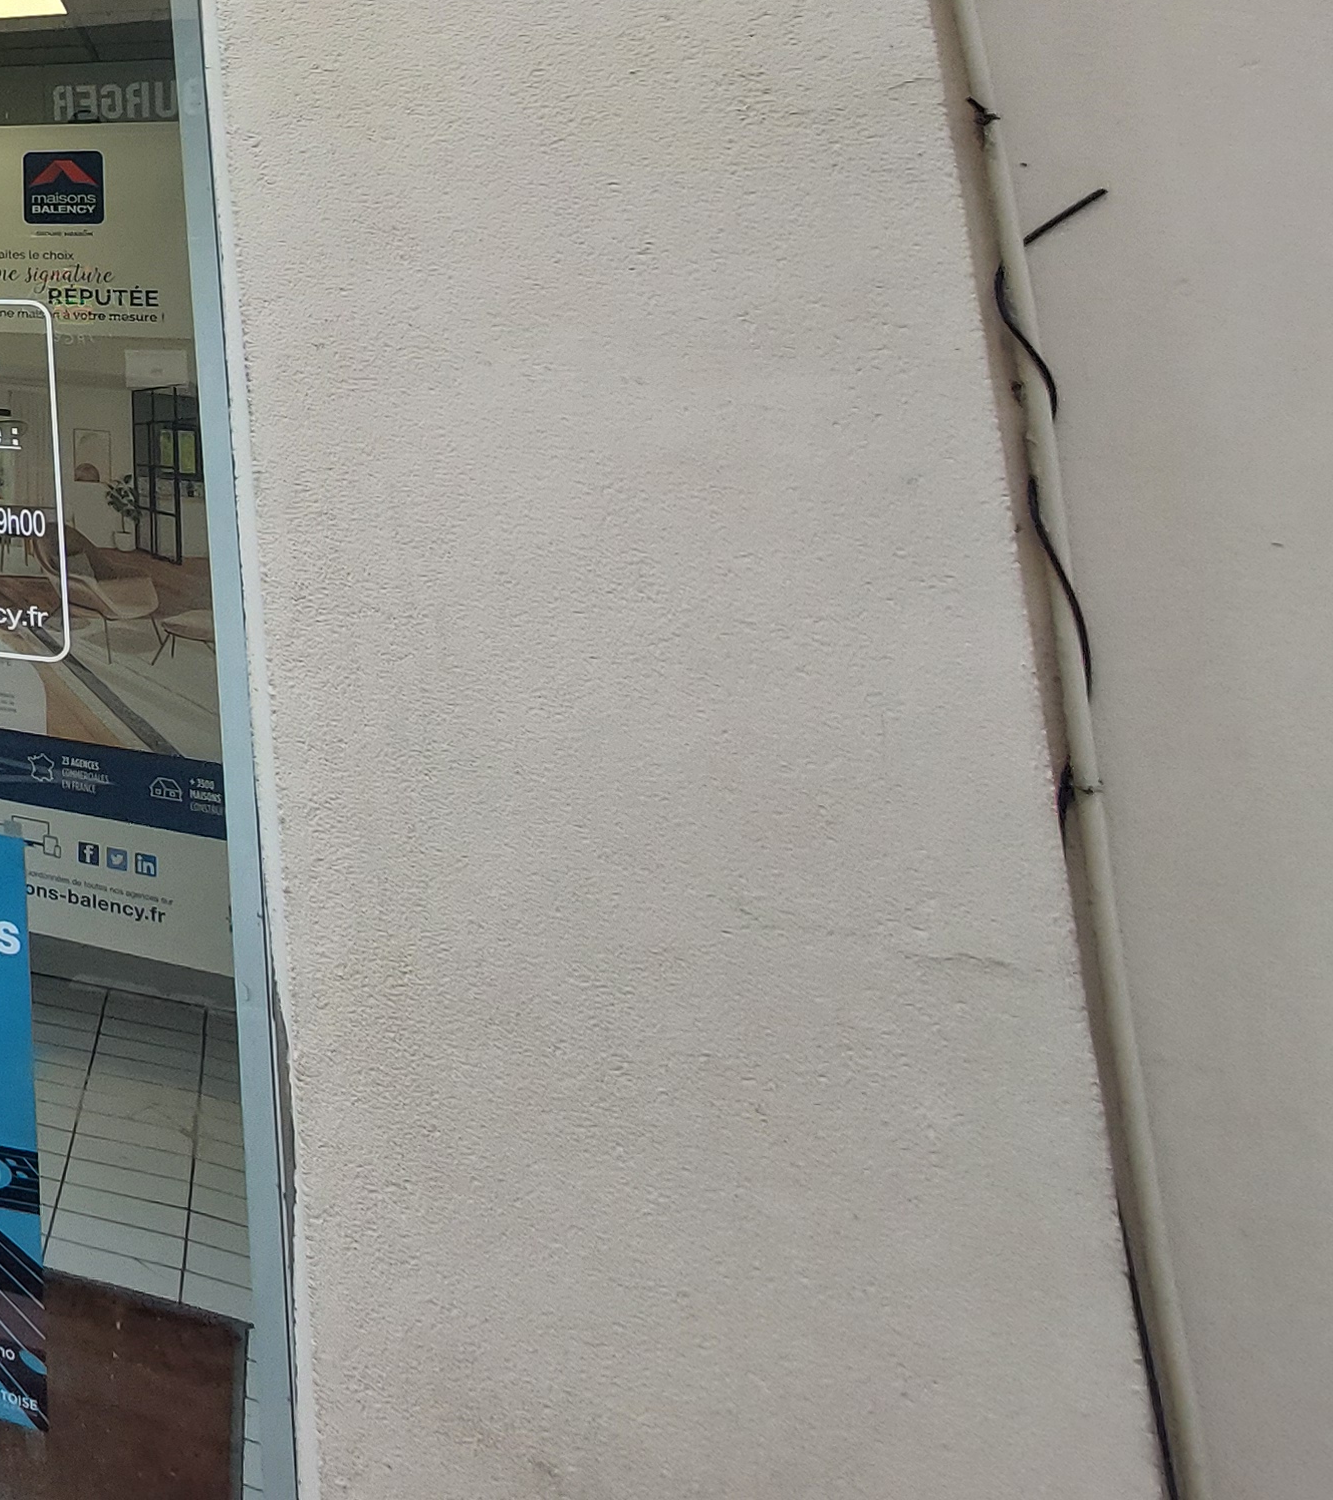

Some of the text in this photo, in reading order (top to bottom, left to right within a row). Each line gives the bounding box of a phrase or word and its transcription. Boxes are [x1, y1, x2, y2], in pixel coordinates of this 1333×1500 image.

[31, 192, 96, 204] maisons
[31, 204, 96, 215] BALENCY
[28, 250, 40, 260] le
[42, 250, 75, 260] choix
[24, 264, 115, 294] signature
[48, 284, 160, 307] RÉPUTÉE
[62, 310, 71, 321] à
[73, 311, 107, 322] votre
[109, 313, 157, 323] mesure
[71, 758, 100, 771] AGENCES
[61, 768, 110, 783] COMMERCIALES
[61, 780, 97, 795] EN FRANCE
